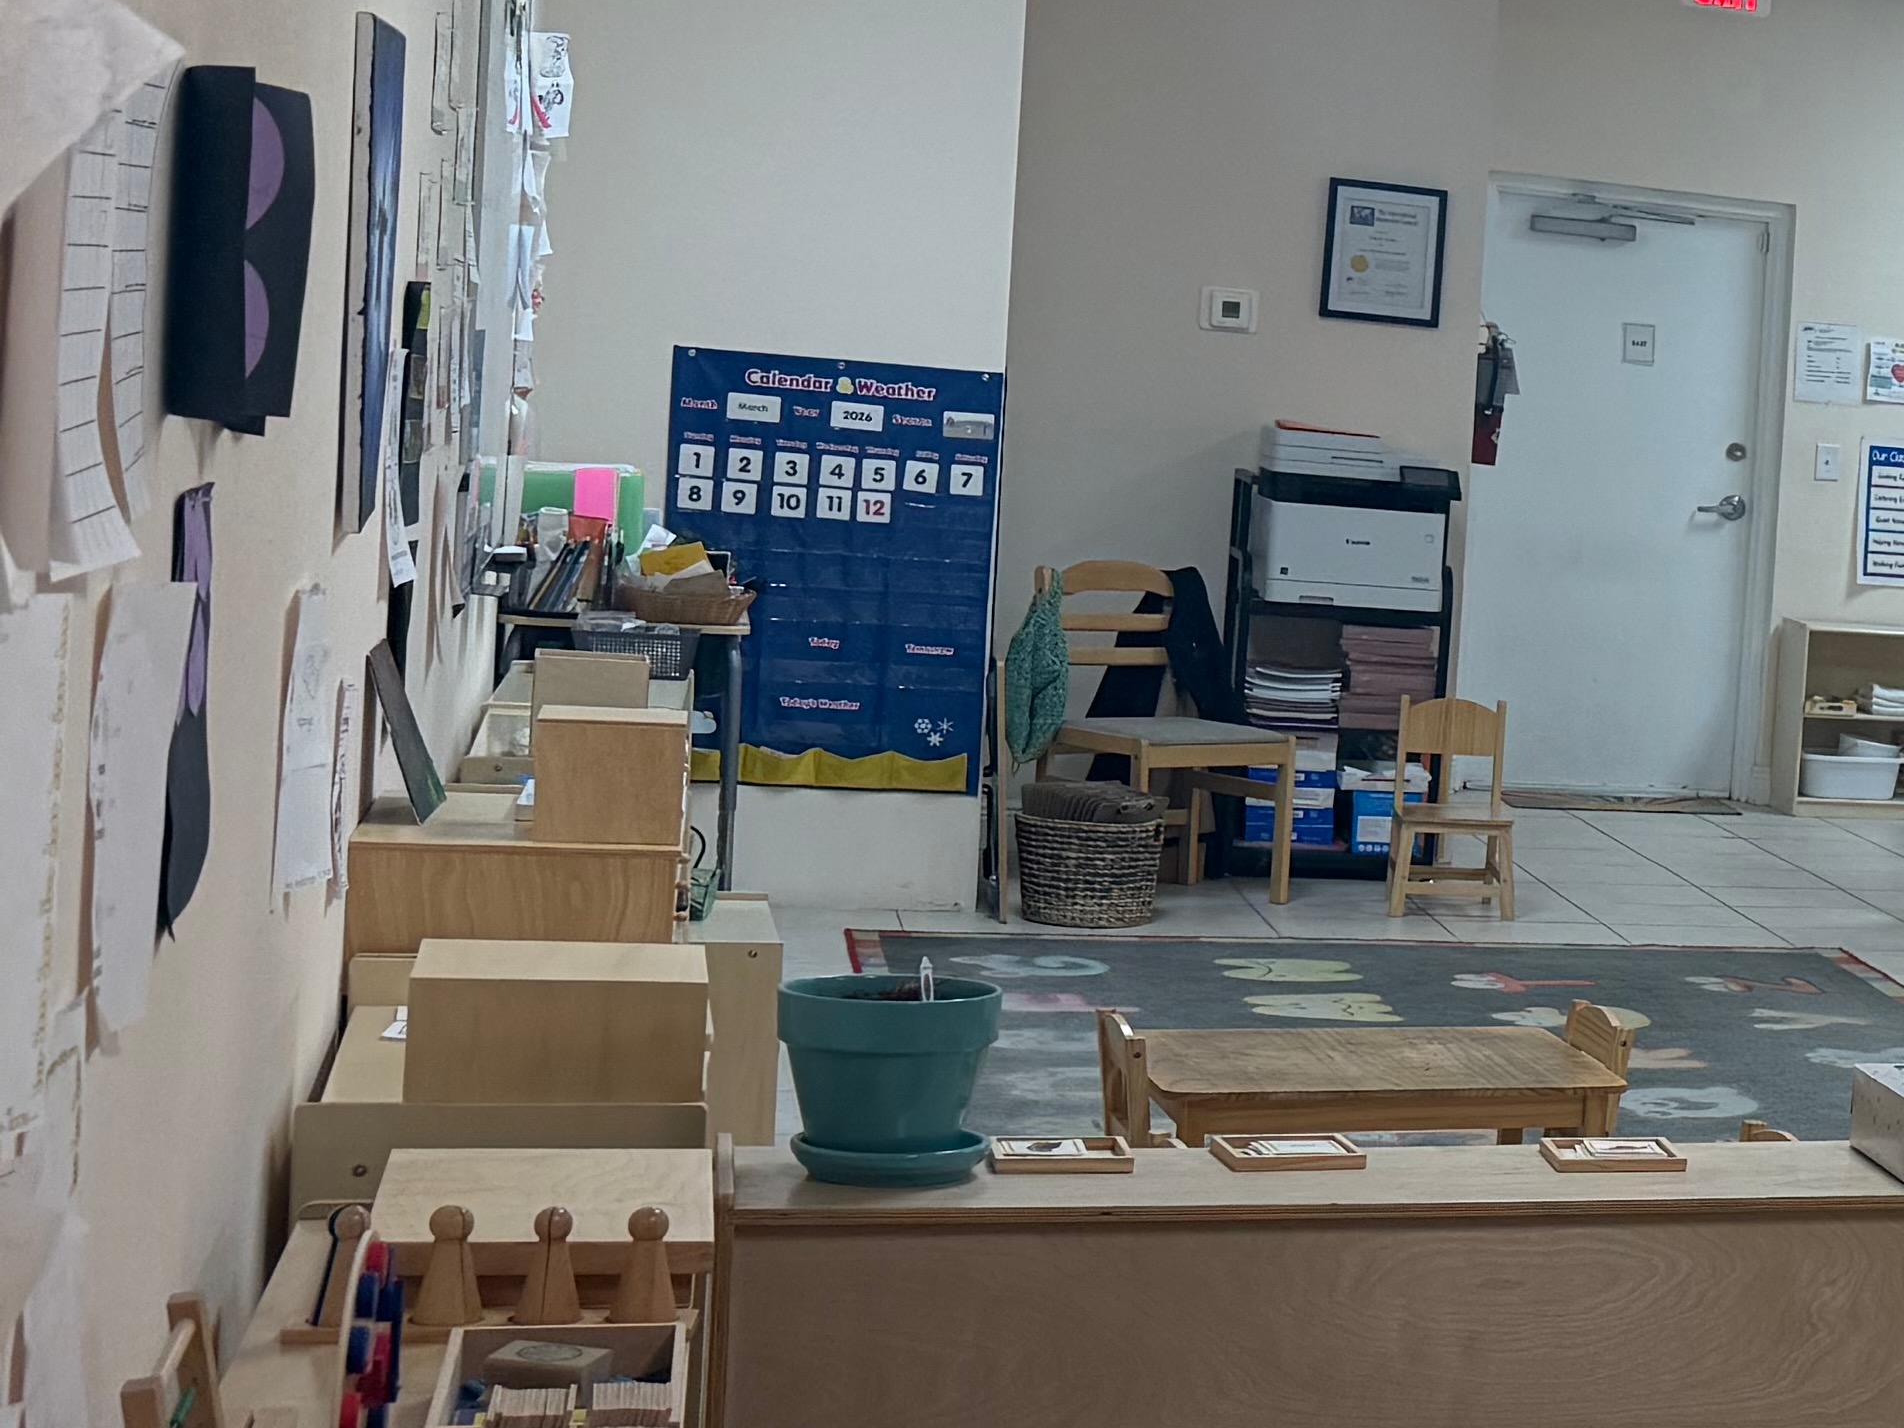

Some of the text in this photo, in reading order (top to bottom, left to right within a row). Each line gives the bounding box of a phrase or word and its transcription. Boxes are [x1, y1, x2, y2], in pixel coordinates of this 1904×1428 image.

[745, 369, 833, 392] Calendar
[856, 378, 936, 401] Weather
[843, 410, 872, 422] 2026
[692, 452, 702, 469] 1
[738, 457, 752, 473] 2
[785, 460, 798, 477] 3
[829, 464, 845, 479] 4
[872, 467, 885, 483] 5
[914, 469, 927, 485] 6
[960, 472, 973, 488] 7
[688, 485, 702, 502] 8
[732, 489, 746, 506] 9
[777, 492, 801, 509] 10
[826, 495, 843, 512] 11
[864, 499, 885, 516] 12
